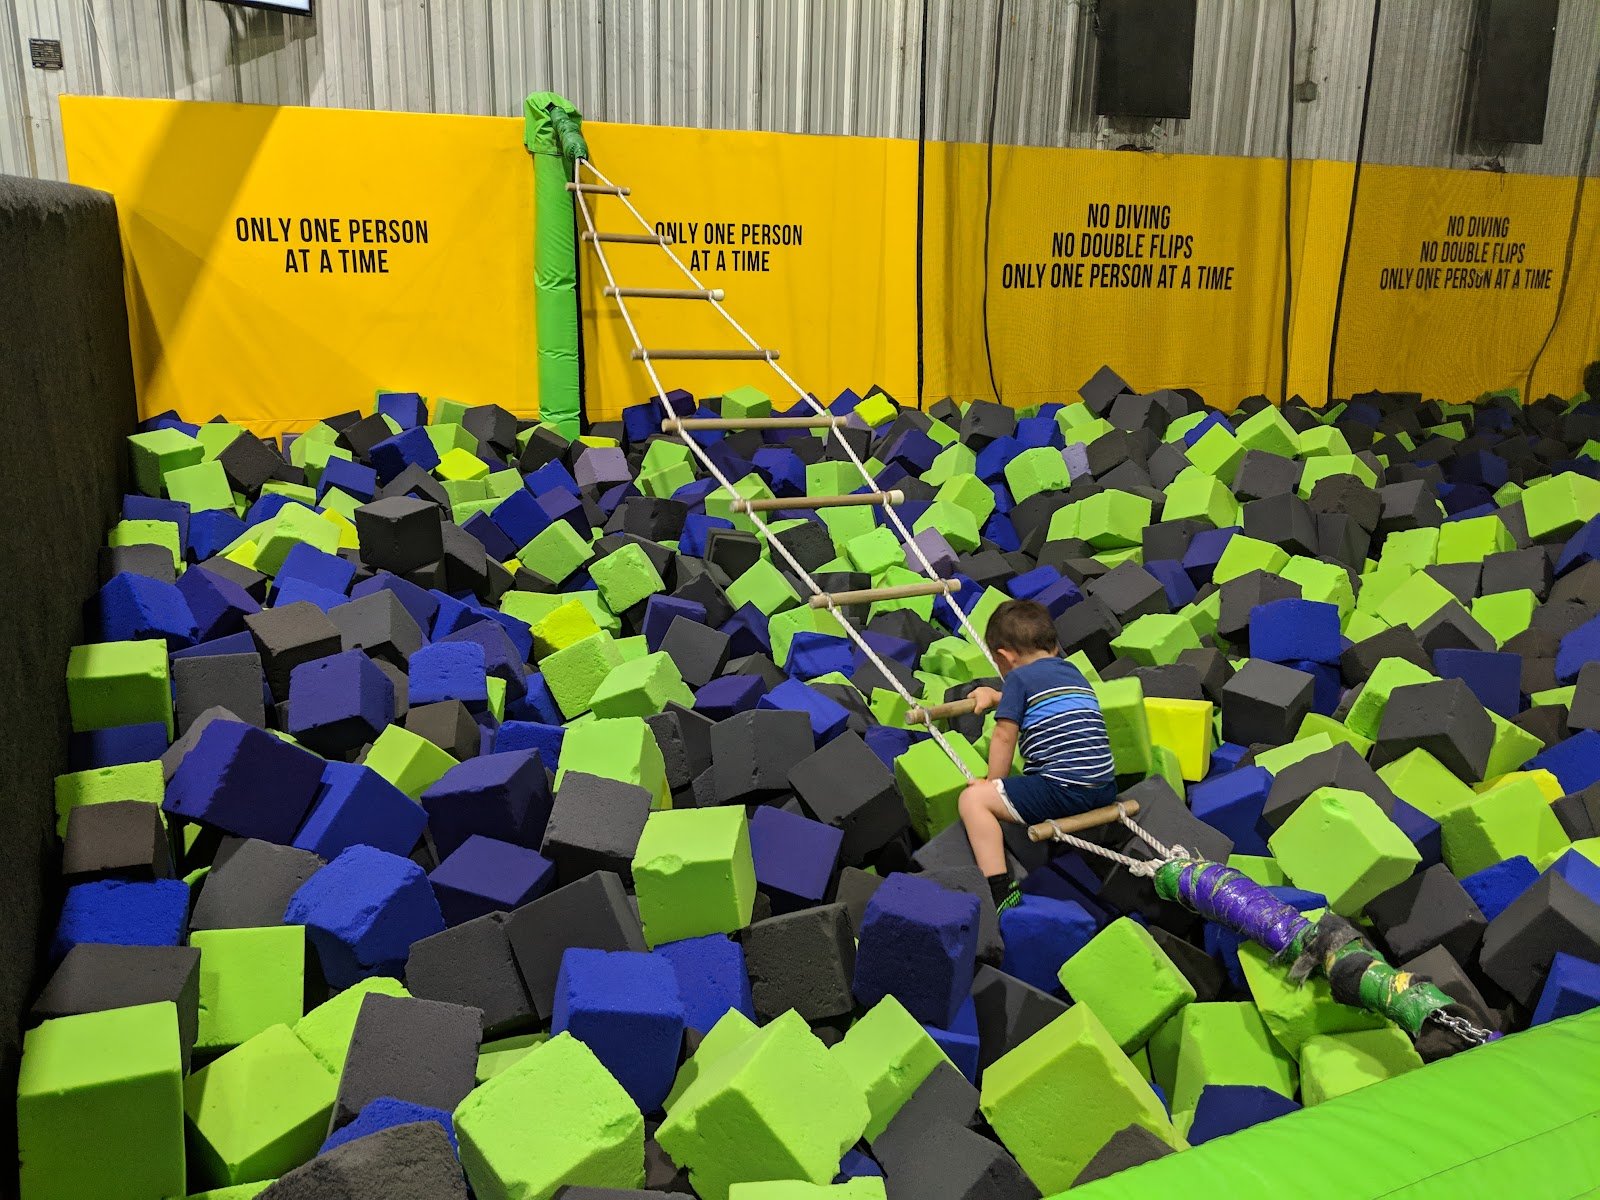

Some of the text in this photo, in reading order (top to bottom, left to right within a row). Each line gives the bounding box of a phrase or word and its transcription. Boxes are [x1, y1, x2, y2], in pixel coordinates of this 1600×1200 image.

[1087, 203, 1171, 230] NO DIVING
[1446, 215, 1510, 238] NO DIVING
[235, 217, 428, 244] ONLY ONE PERSON
[655, 221, 803, 246] ONLY ONE PERSON
[1051, 232, 1194, 259] NO DOUBLE FLIPS
[1419, 240, 1526, 264] NO DOUBLE FLIPS
[285, 248, 389, 274] AT A TIME
[690, 249, 770, 272] AT A TIME
[1002, 262, 1235, 291] ONLY ONE PERSON AT A TIME
[1379, 267, 1553, 291] ONLY ONE PERSON AT A TIME
